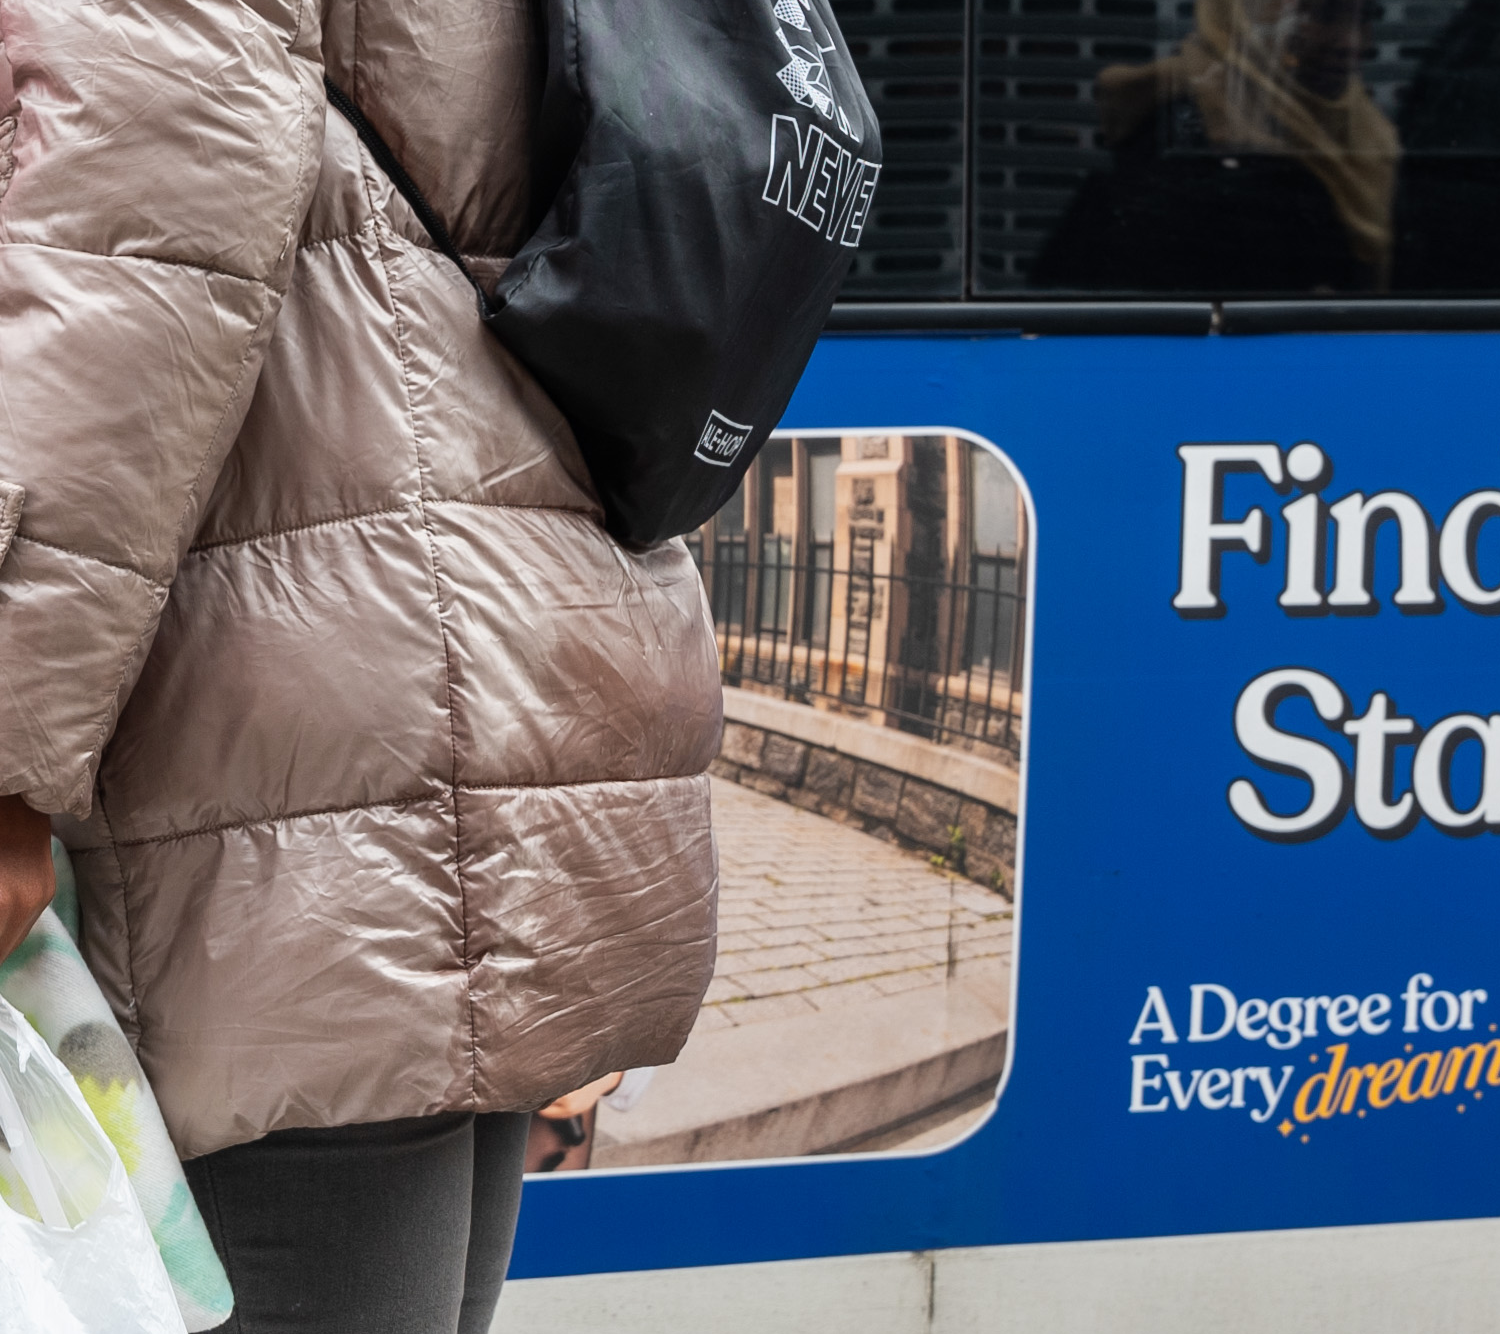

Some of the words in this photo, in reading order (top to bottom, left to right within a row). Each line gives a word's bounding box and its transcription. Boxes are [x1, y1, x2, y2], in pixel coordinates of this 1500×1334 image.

[761, 113, 883, 248] NEVE
[701, 423, 744, 457] ALE-HOP
[1129, 985, 1179, 1045] A
[1187, 982, 1392, 1050] Degree
[1401, 972, 1488, 1033] for
[1128, 1053, 1295, 1123] Every
